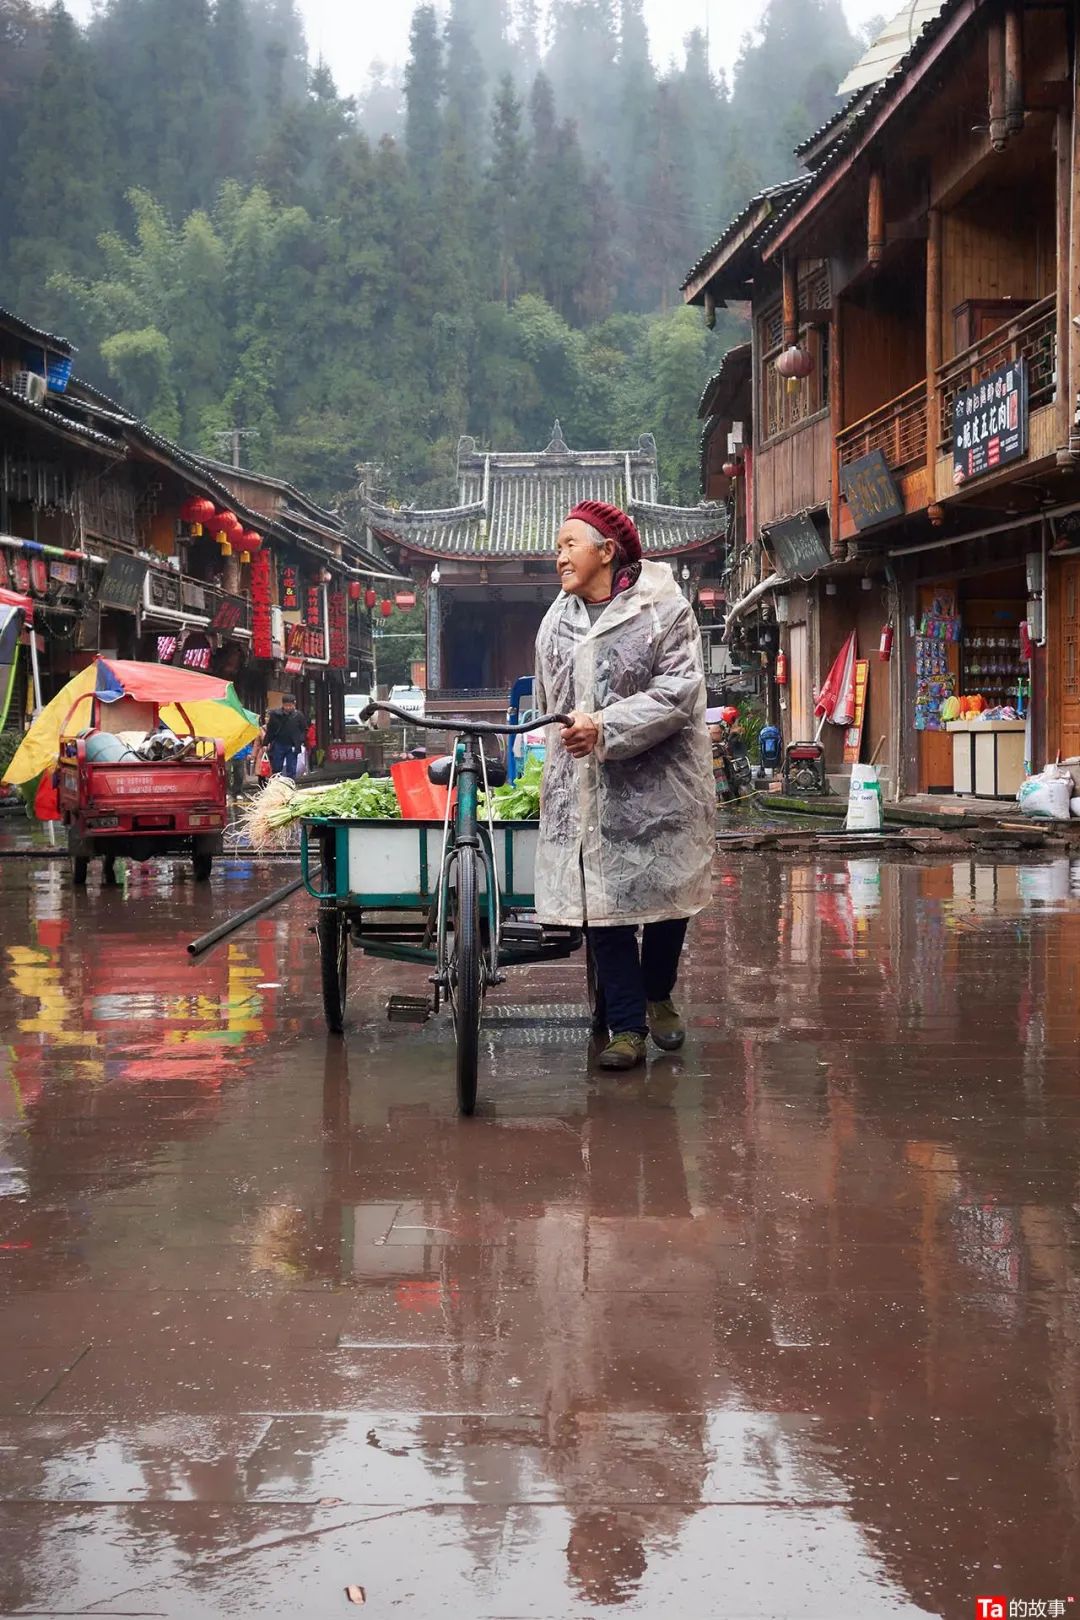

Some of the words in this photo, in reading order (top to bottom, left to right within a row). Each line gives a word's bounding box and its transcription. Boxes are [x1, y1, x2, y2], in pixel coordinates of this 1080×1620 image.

[962, 404, 1007, 449] 脆皮五花肉
